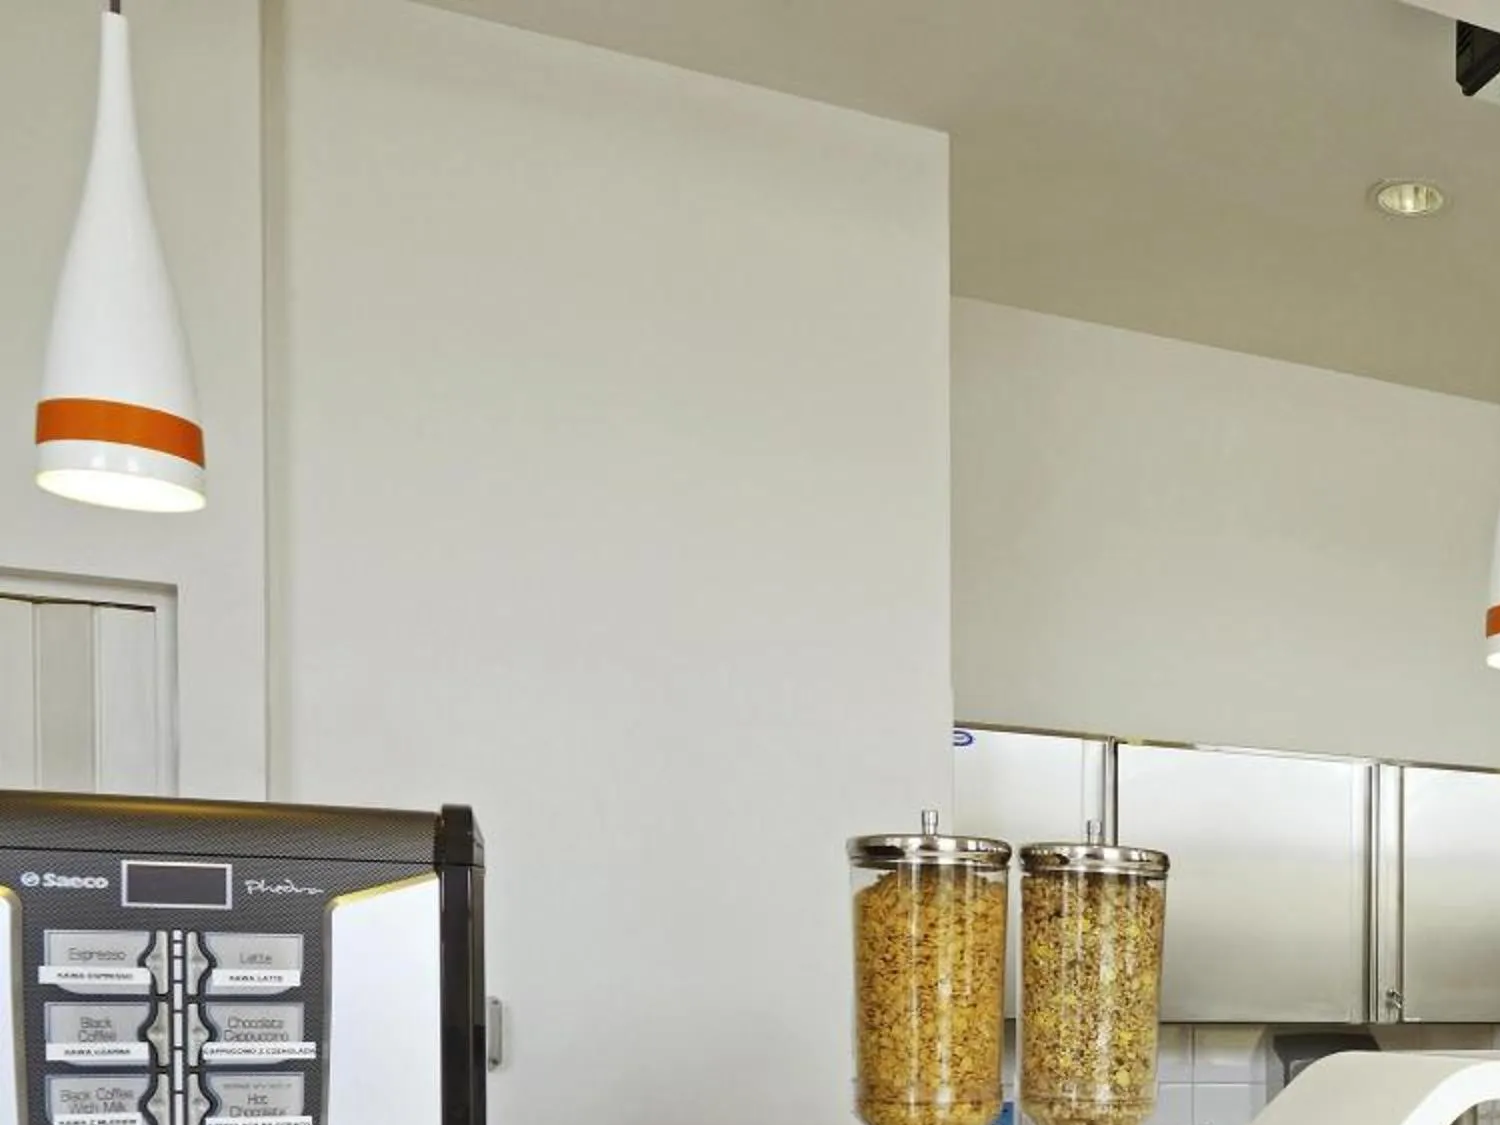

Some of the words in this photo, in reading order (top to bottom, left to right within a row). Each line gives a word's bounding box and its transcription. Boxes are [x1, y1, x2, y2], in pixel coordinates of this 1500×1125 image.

[42, 872, 109, 889] Saeco
[68, 946, 127, 962] Espresso
[239, 951, 273, 965] Latte
[80, 1015, 113, 1029] Black
